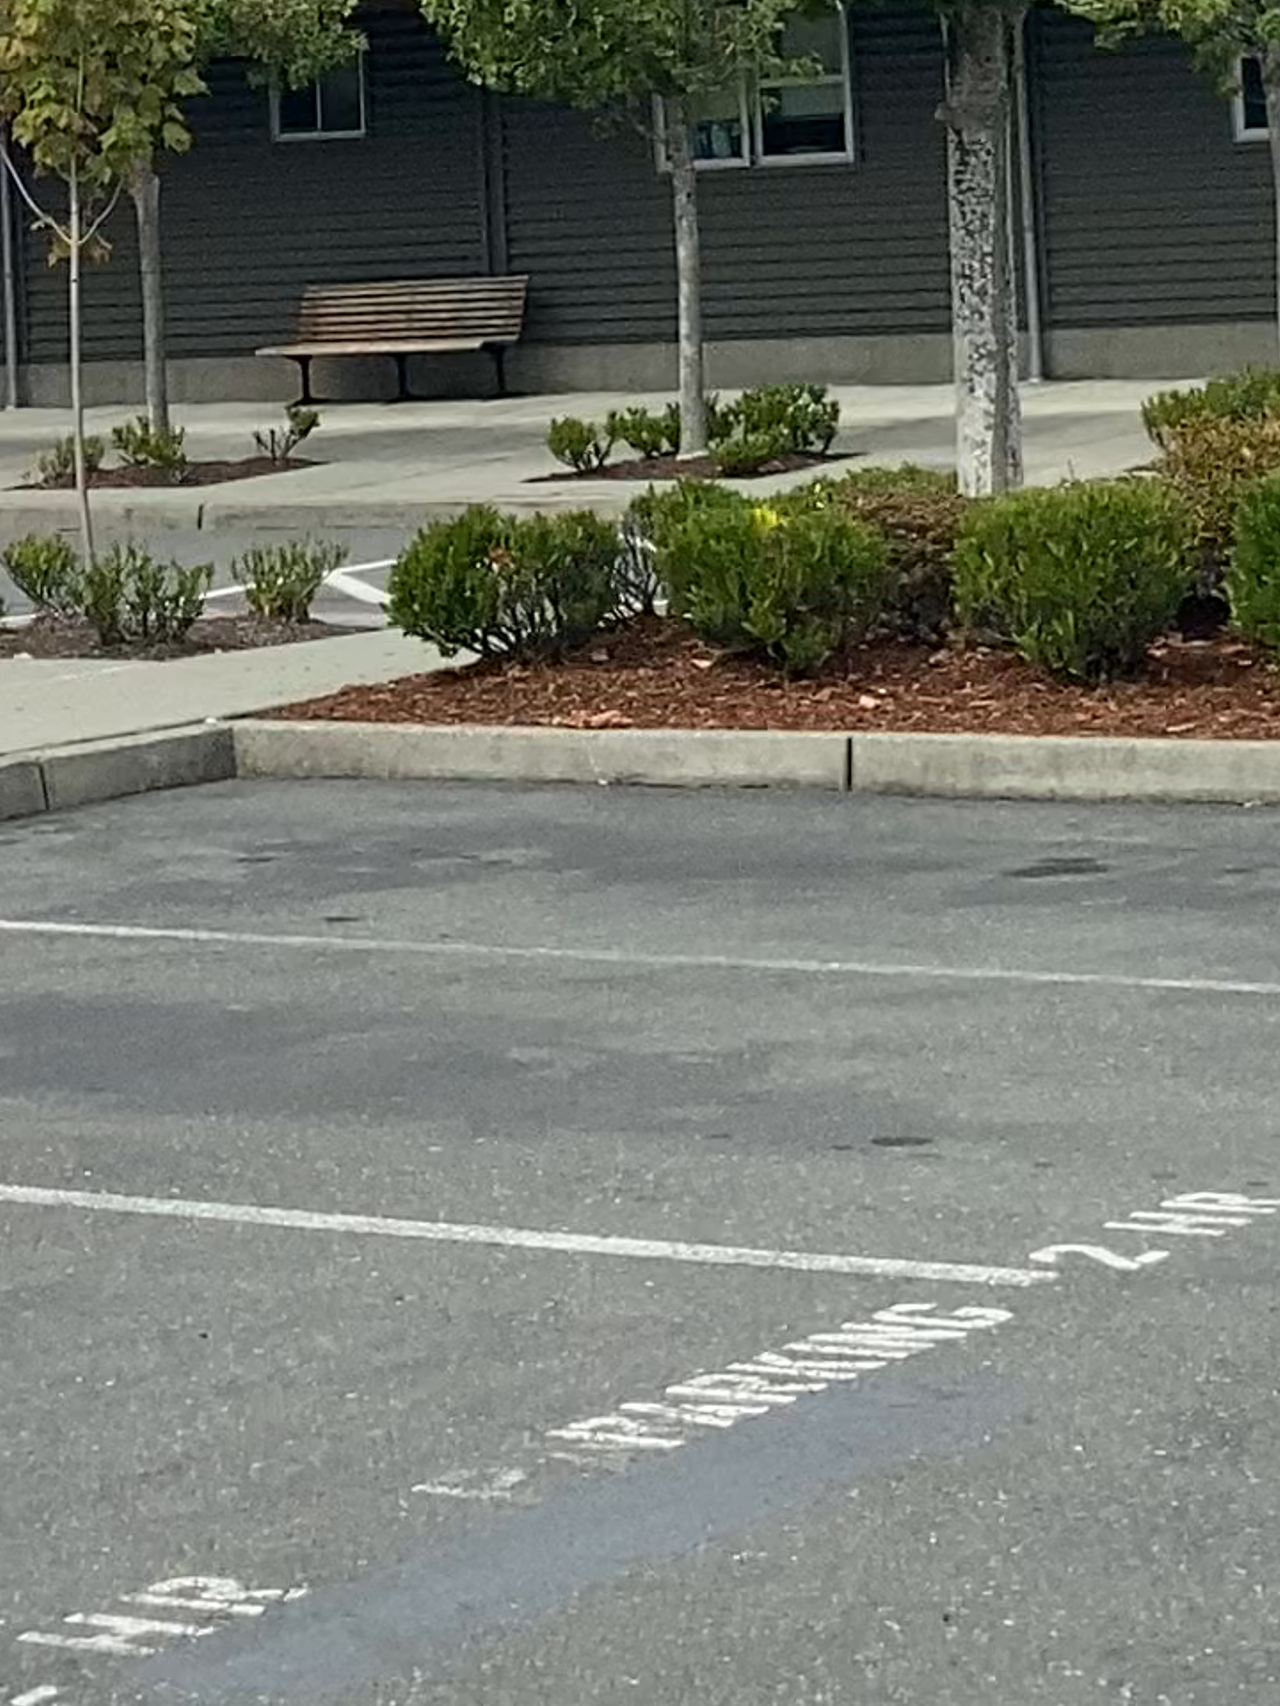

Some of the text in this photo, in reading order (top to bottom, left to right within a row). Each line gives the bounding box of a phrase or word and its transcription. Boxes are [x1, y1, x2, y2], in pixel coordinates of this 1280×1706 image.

[1028, 1243, 1170, 1271] 2
[18, 1575, 310, 1656] HR
[544, 1301, 1015, 1449] PARKING
